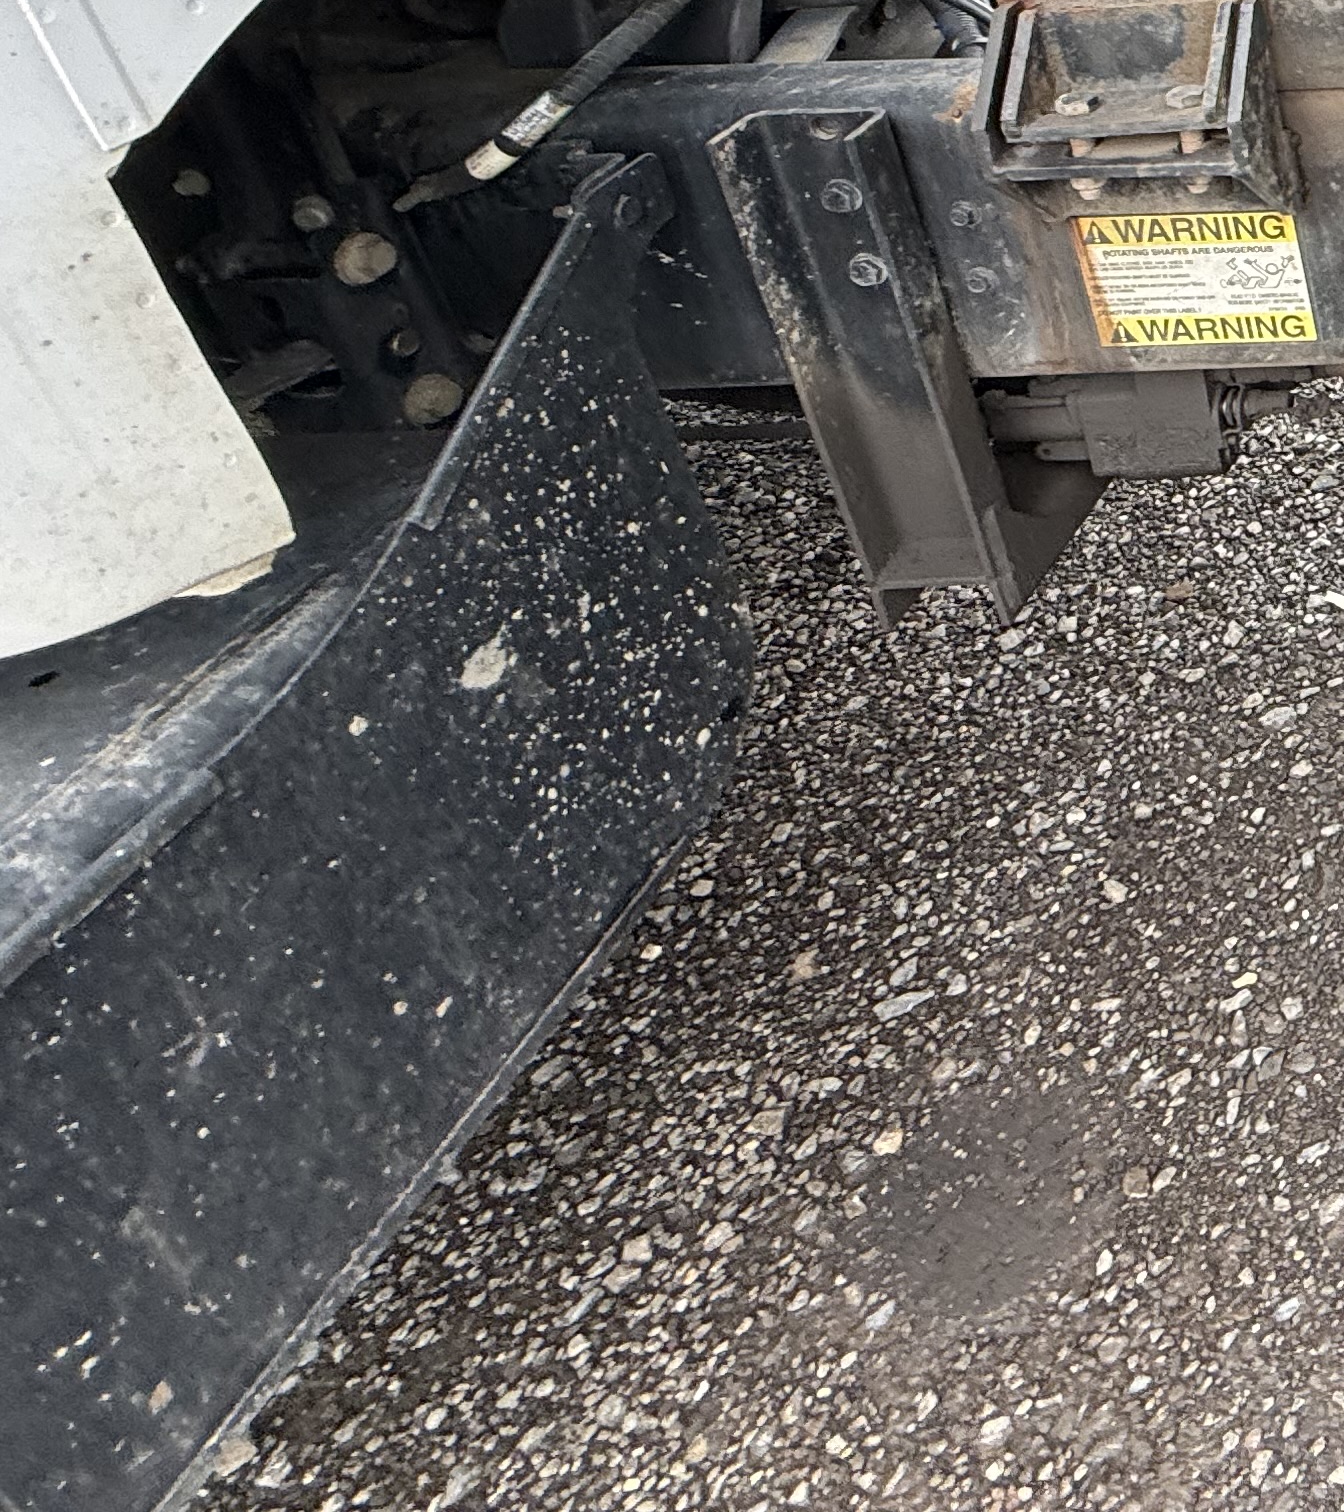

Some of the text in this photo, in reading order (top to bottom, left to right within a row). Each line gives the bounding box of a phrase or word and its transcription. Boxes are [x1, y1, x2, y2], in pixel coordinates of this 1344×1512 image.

[1111, 214, 1286, 244] WARNING
[1102, 245, 1274, 258] ROTATING SHAFTS ARE DANGEROUS
[1137, 314, 1306, 343] WARNING
